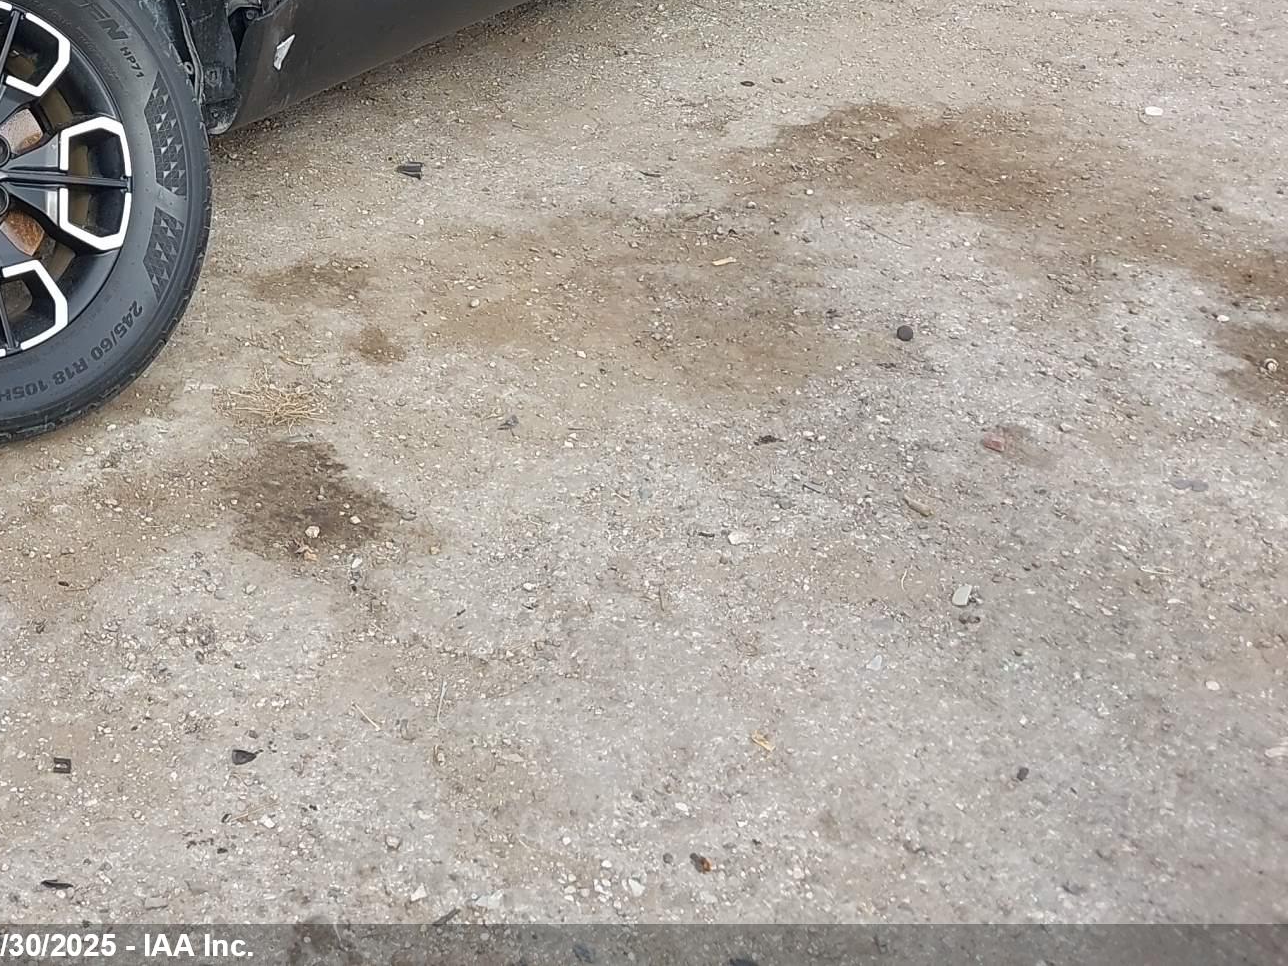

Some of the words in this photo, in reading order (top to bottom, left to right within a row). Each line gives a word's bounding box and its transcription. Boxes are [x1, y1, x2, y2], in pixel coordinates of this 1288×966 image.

[120, 46, 145, 79] HP71
[90, 300, 143, 362] 245/60
[52, 356, 89, 385] R18
